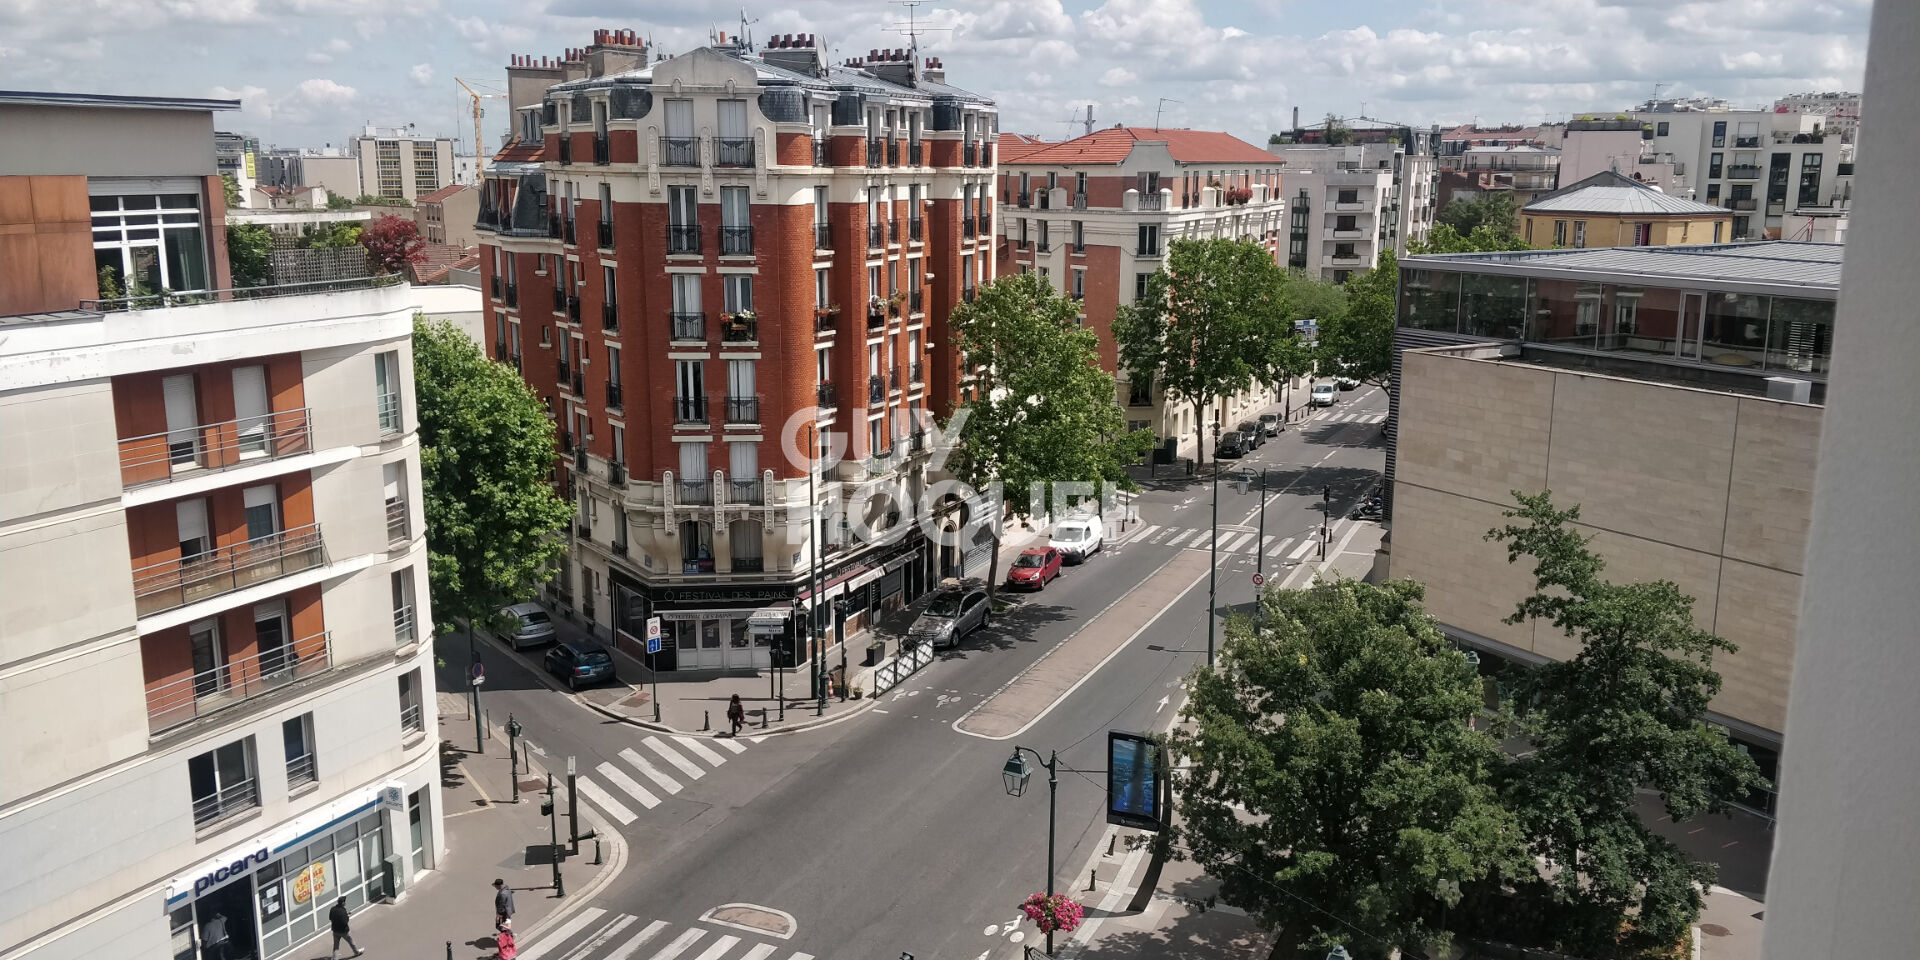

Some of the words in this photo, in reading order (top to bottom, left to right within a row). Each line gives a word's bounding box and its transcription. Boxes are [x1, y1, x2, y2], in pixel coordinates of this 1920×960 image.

[679, 591, 725, 600] FESTIVAL
[732, 591, 751, 599] DES
[758, 590, 788, 599] PAINS
[194, 846, 269, 898] picard
